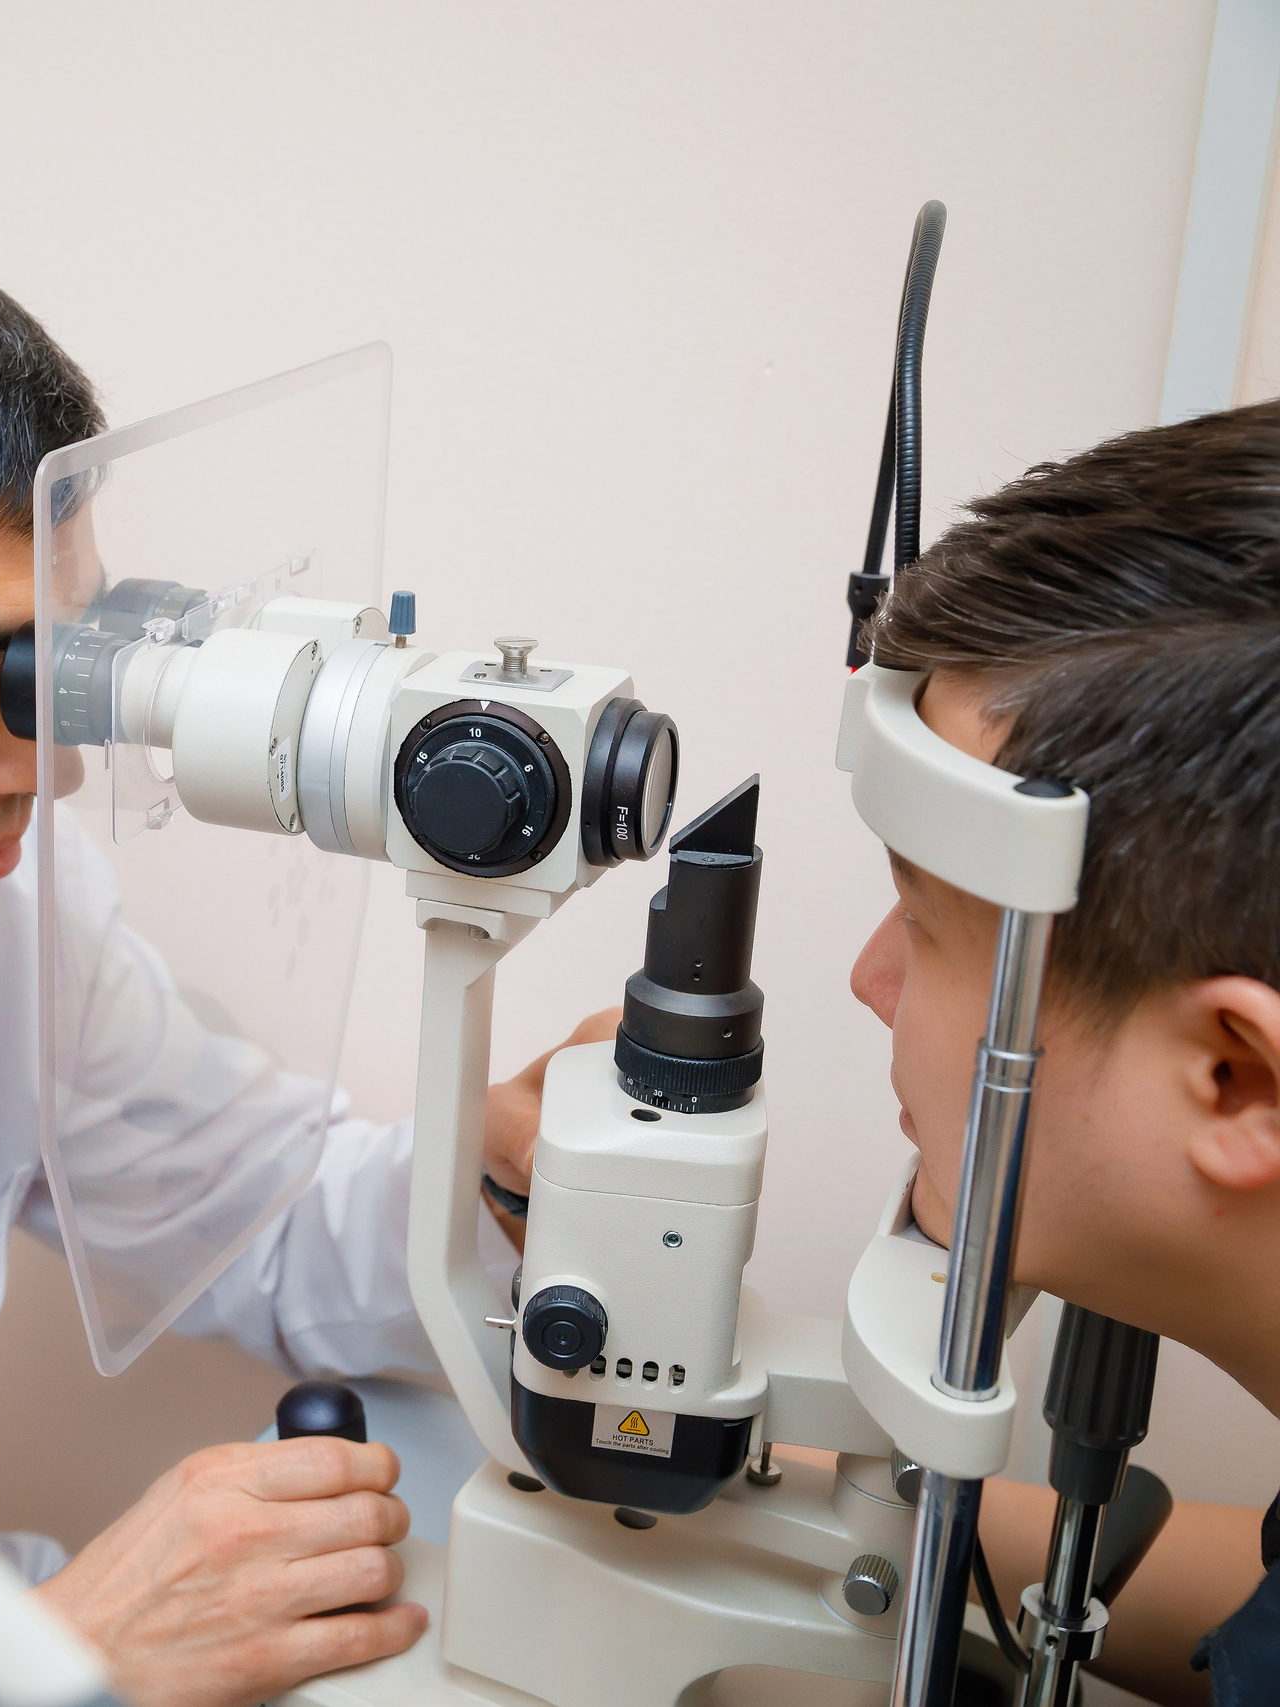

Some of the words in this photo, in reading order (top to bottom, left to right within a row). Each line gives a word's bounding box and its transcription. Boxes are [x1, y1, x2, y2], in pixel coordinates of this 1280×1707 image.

[65, 653, 76, 661] 2
[58, 687, 68, 695] 4
[468, 727, 482, 738] 10
[416, 751, 429, 765] 16
[524, 764, 534, 773] 6
[616, 806, 629, 841] F=100
[521, 824, 534, 837] 16
[653, 1089, 663, 1098] 30
[612, 1434, 628, 1442] HOT
[629, 1436, 654, 1446] PARTS
[649, 1447, 669, 1455] cooling
